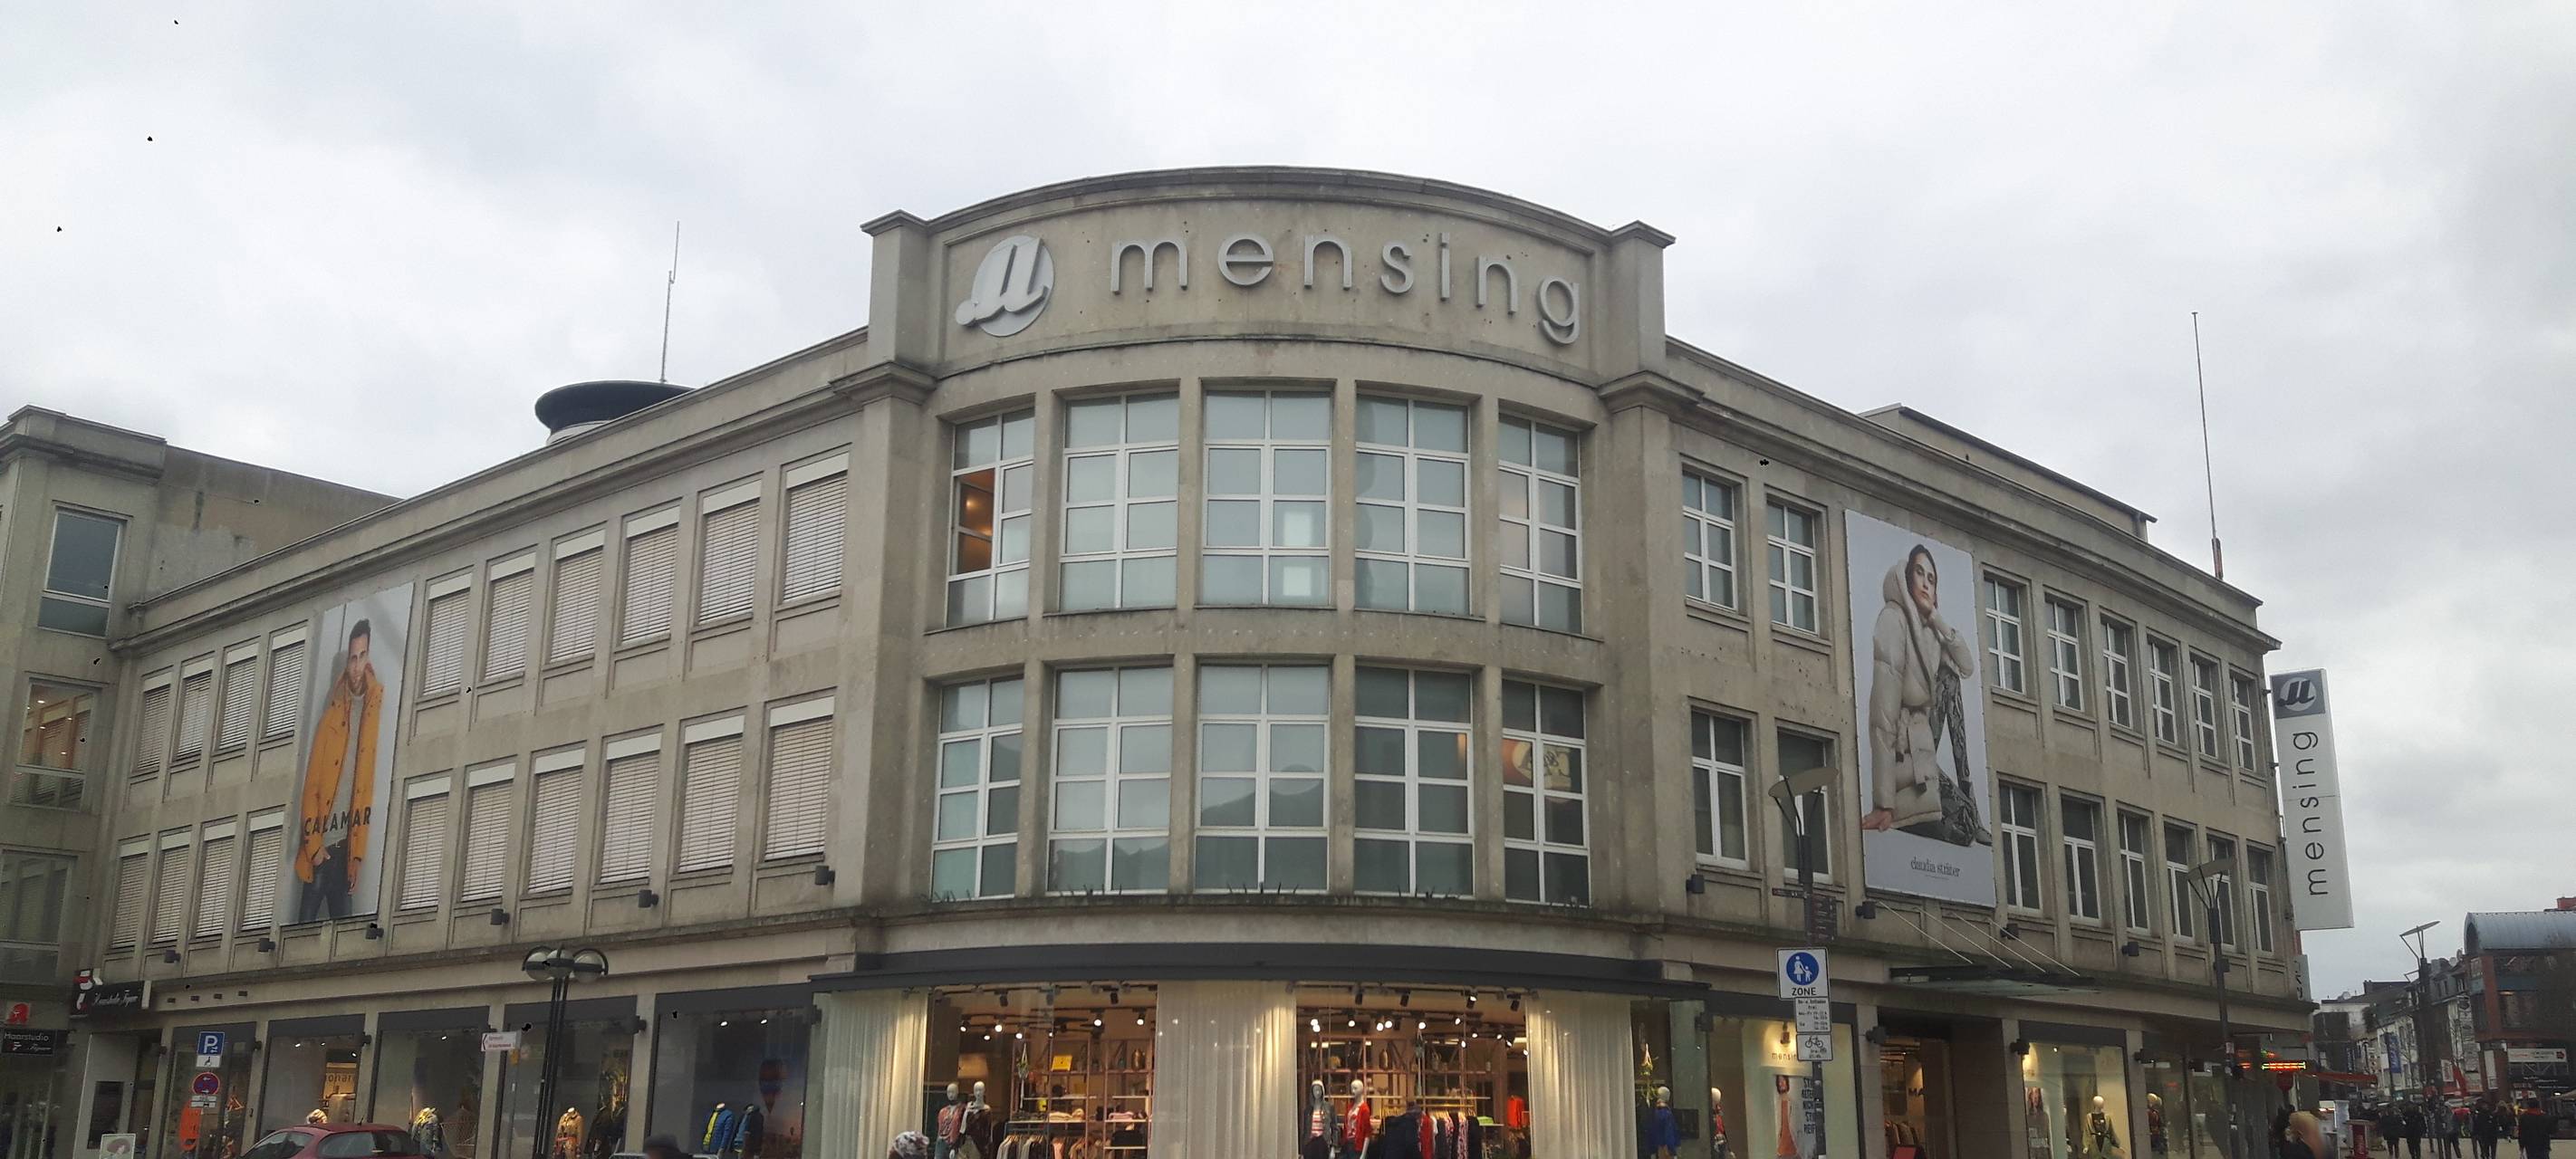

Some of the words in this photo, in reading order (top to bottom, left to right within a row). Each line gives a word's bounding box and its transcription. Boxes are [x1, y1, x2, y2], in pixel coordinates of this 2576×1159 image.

[1110, 232, 1581, 346] mensing
[304, 806, 371, 835] CALAMAR
[2292, 731, 2329, 896] mensing
[1910, 856, 1936, 873] claudia
[1792, 987, 1818, 996] ZONE
[203, 1035, 218, 1054] P
